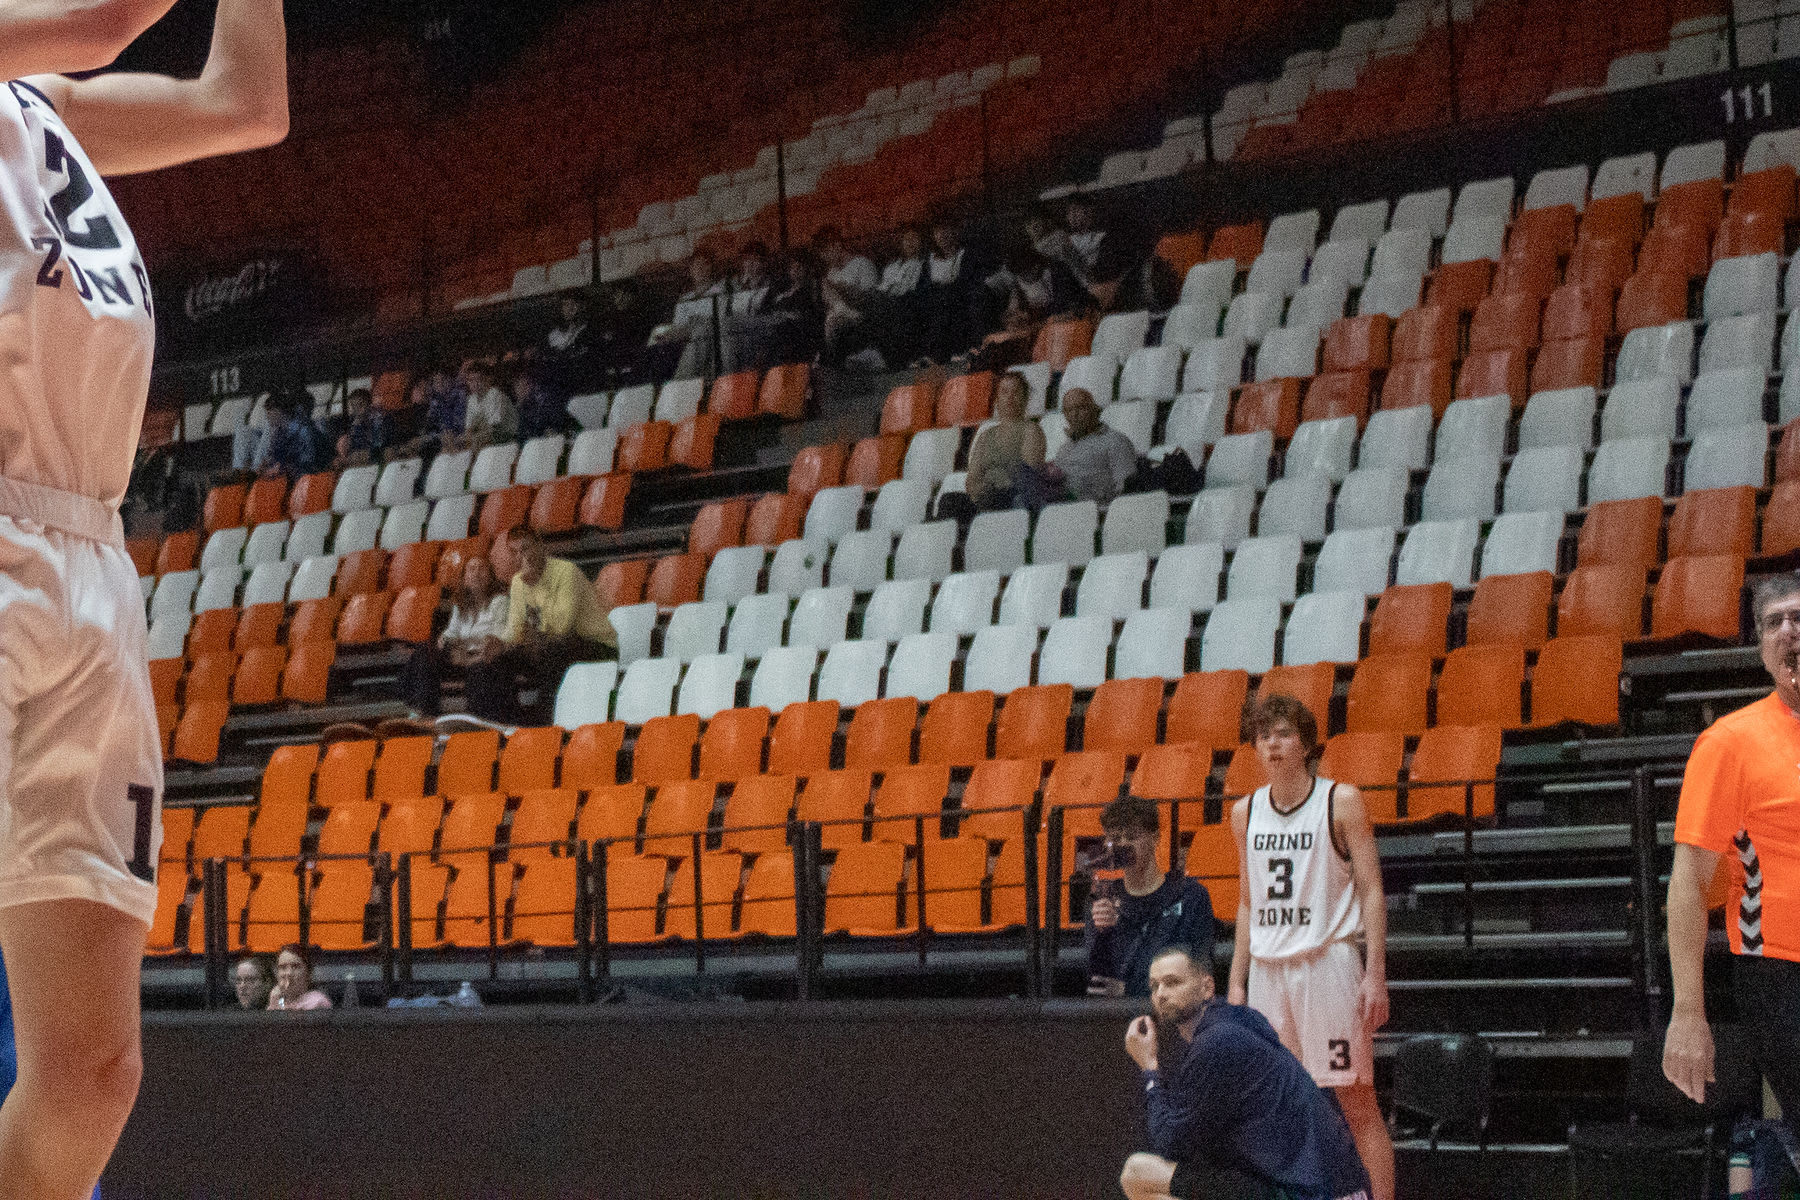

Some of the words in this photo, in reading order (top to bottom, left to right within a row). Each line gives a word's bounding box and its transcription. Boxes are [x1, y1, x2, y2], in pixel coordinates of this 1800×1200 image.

[1720, 82, 1773, 125] 111
[43, 127, 122, 250] 2
[210, 366, 241, 395] 113
[1254, 832, 1313, 851] GRIND
[1267, 858, 1294, 901] 3
[1258, 907, 1312, 927] ZONE
[1328, 1039, 1351, 1071] 3
